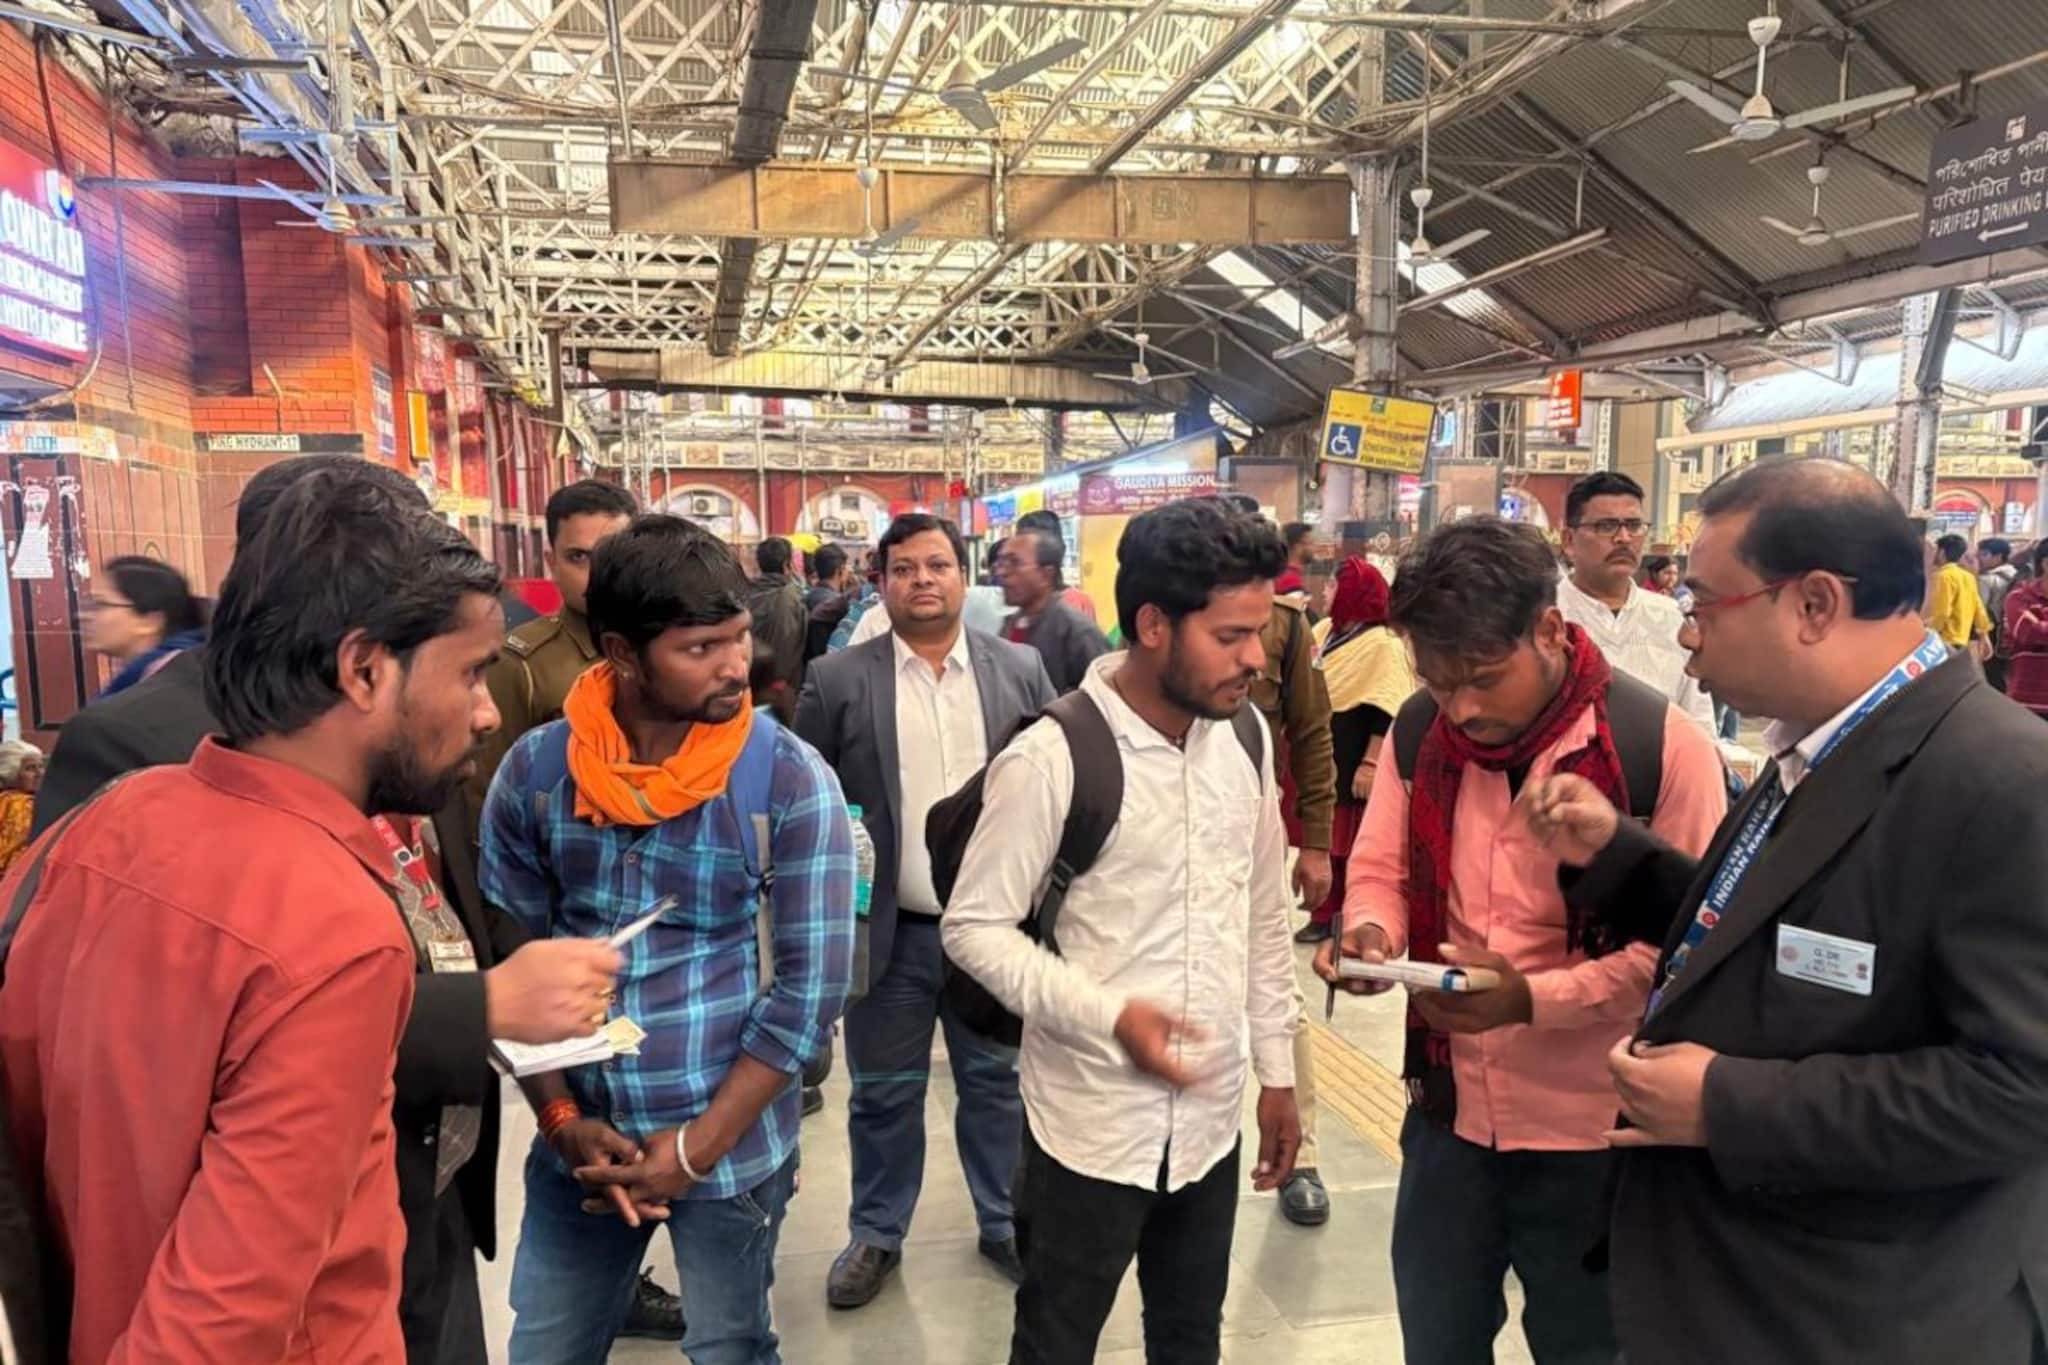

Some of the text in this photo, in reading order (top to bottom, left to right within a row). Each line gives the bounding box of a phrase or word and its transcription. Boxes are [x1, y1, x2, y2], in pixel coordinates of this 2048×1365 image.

[1932, 177, 2011, 211] परिशोधित
[1928, 209, 1980, 239] PURIFIED
[1982, 192, 2043, 226] DRINKING
[1167, 473, 1216, 488] MISSION
[1711, 855, 1750, 910] INDIAN
